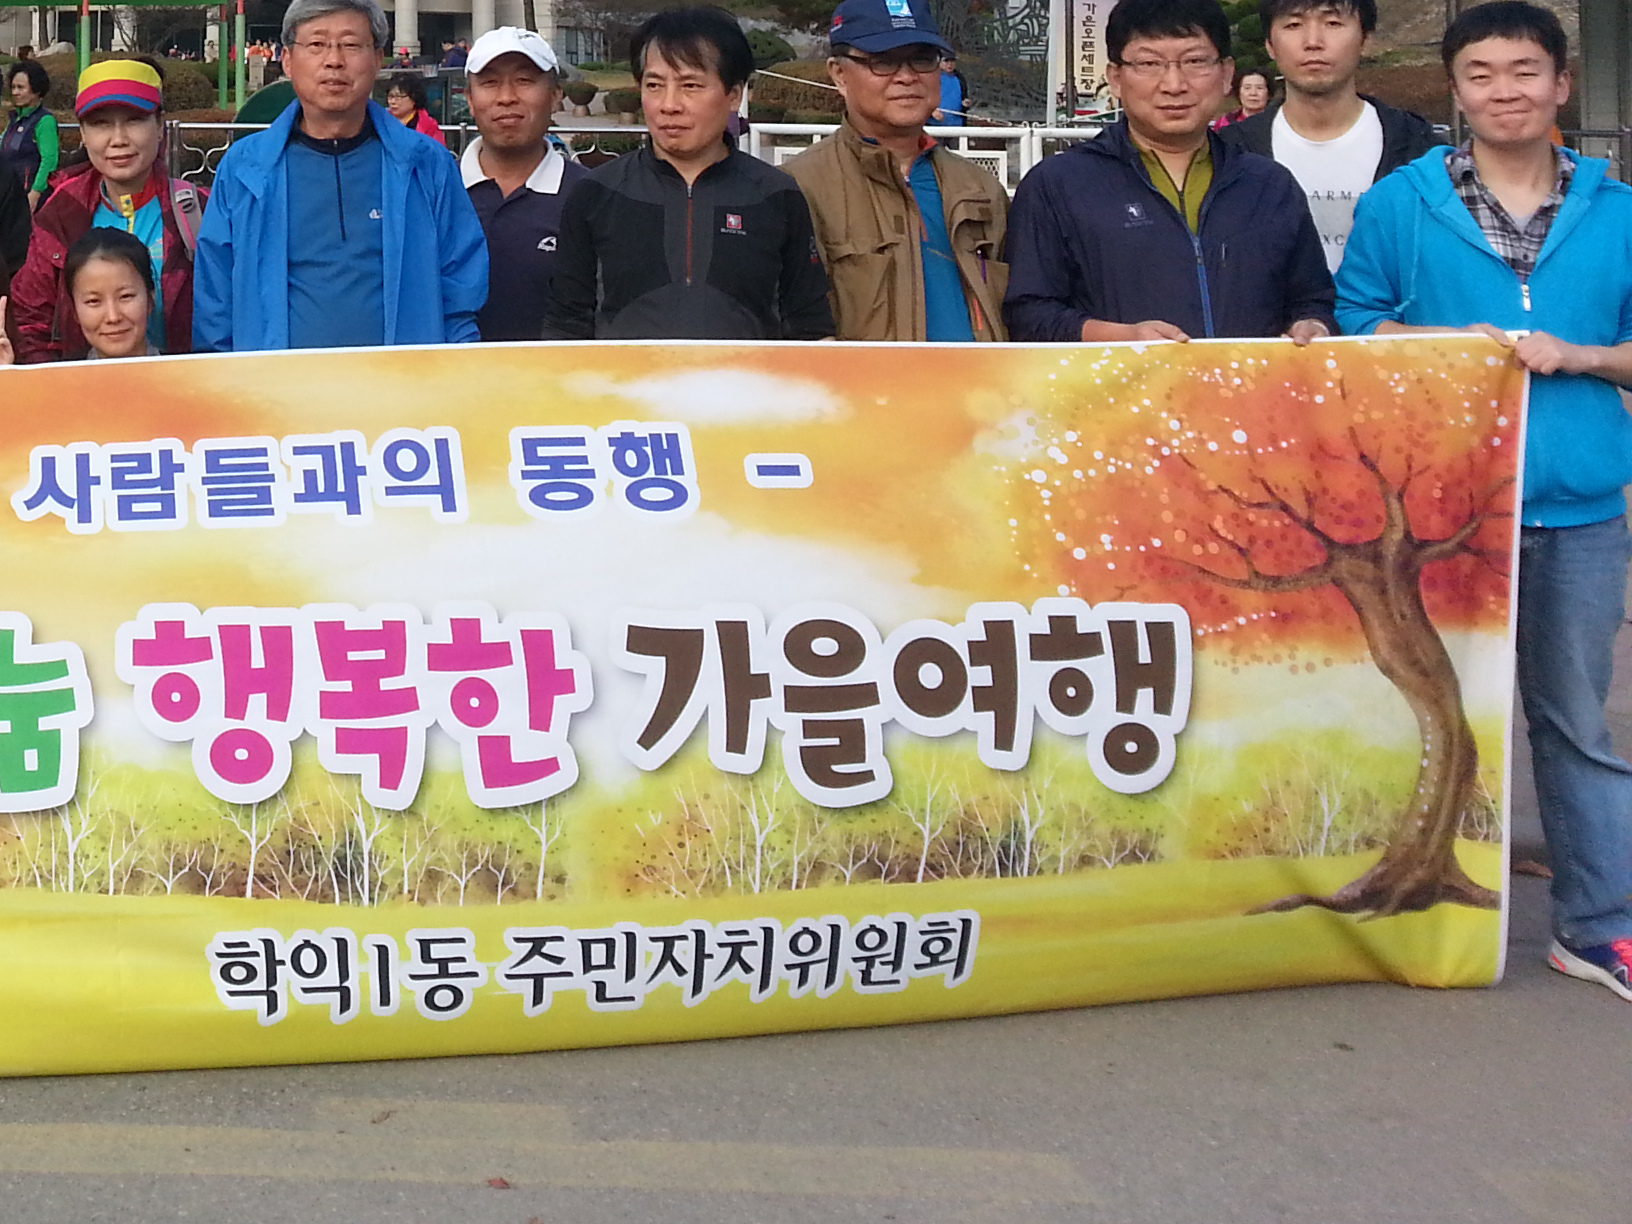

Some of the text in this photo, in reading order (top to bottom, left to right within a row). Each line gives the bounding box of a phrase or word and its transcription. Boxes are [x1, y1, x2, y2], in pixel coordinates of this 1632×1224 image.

[23, 437, 458, 525] 사람들과의
[520, 431, 690, 512] 동행
[131, 617, 576, 791] 행복한
[625, 617, 1176, 789] 가을여행
[214, 917, 971, 1019] 학익1동 주민자치위원회
